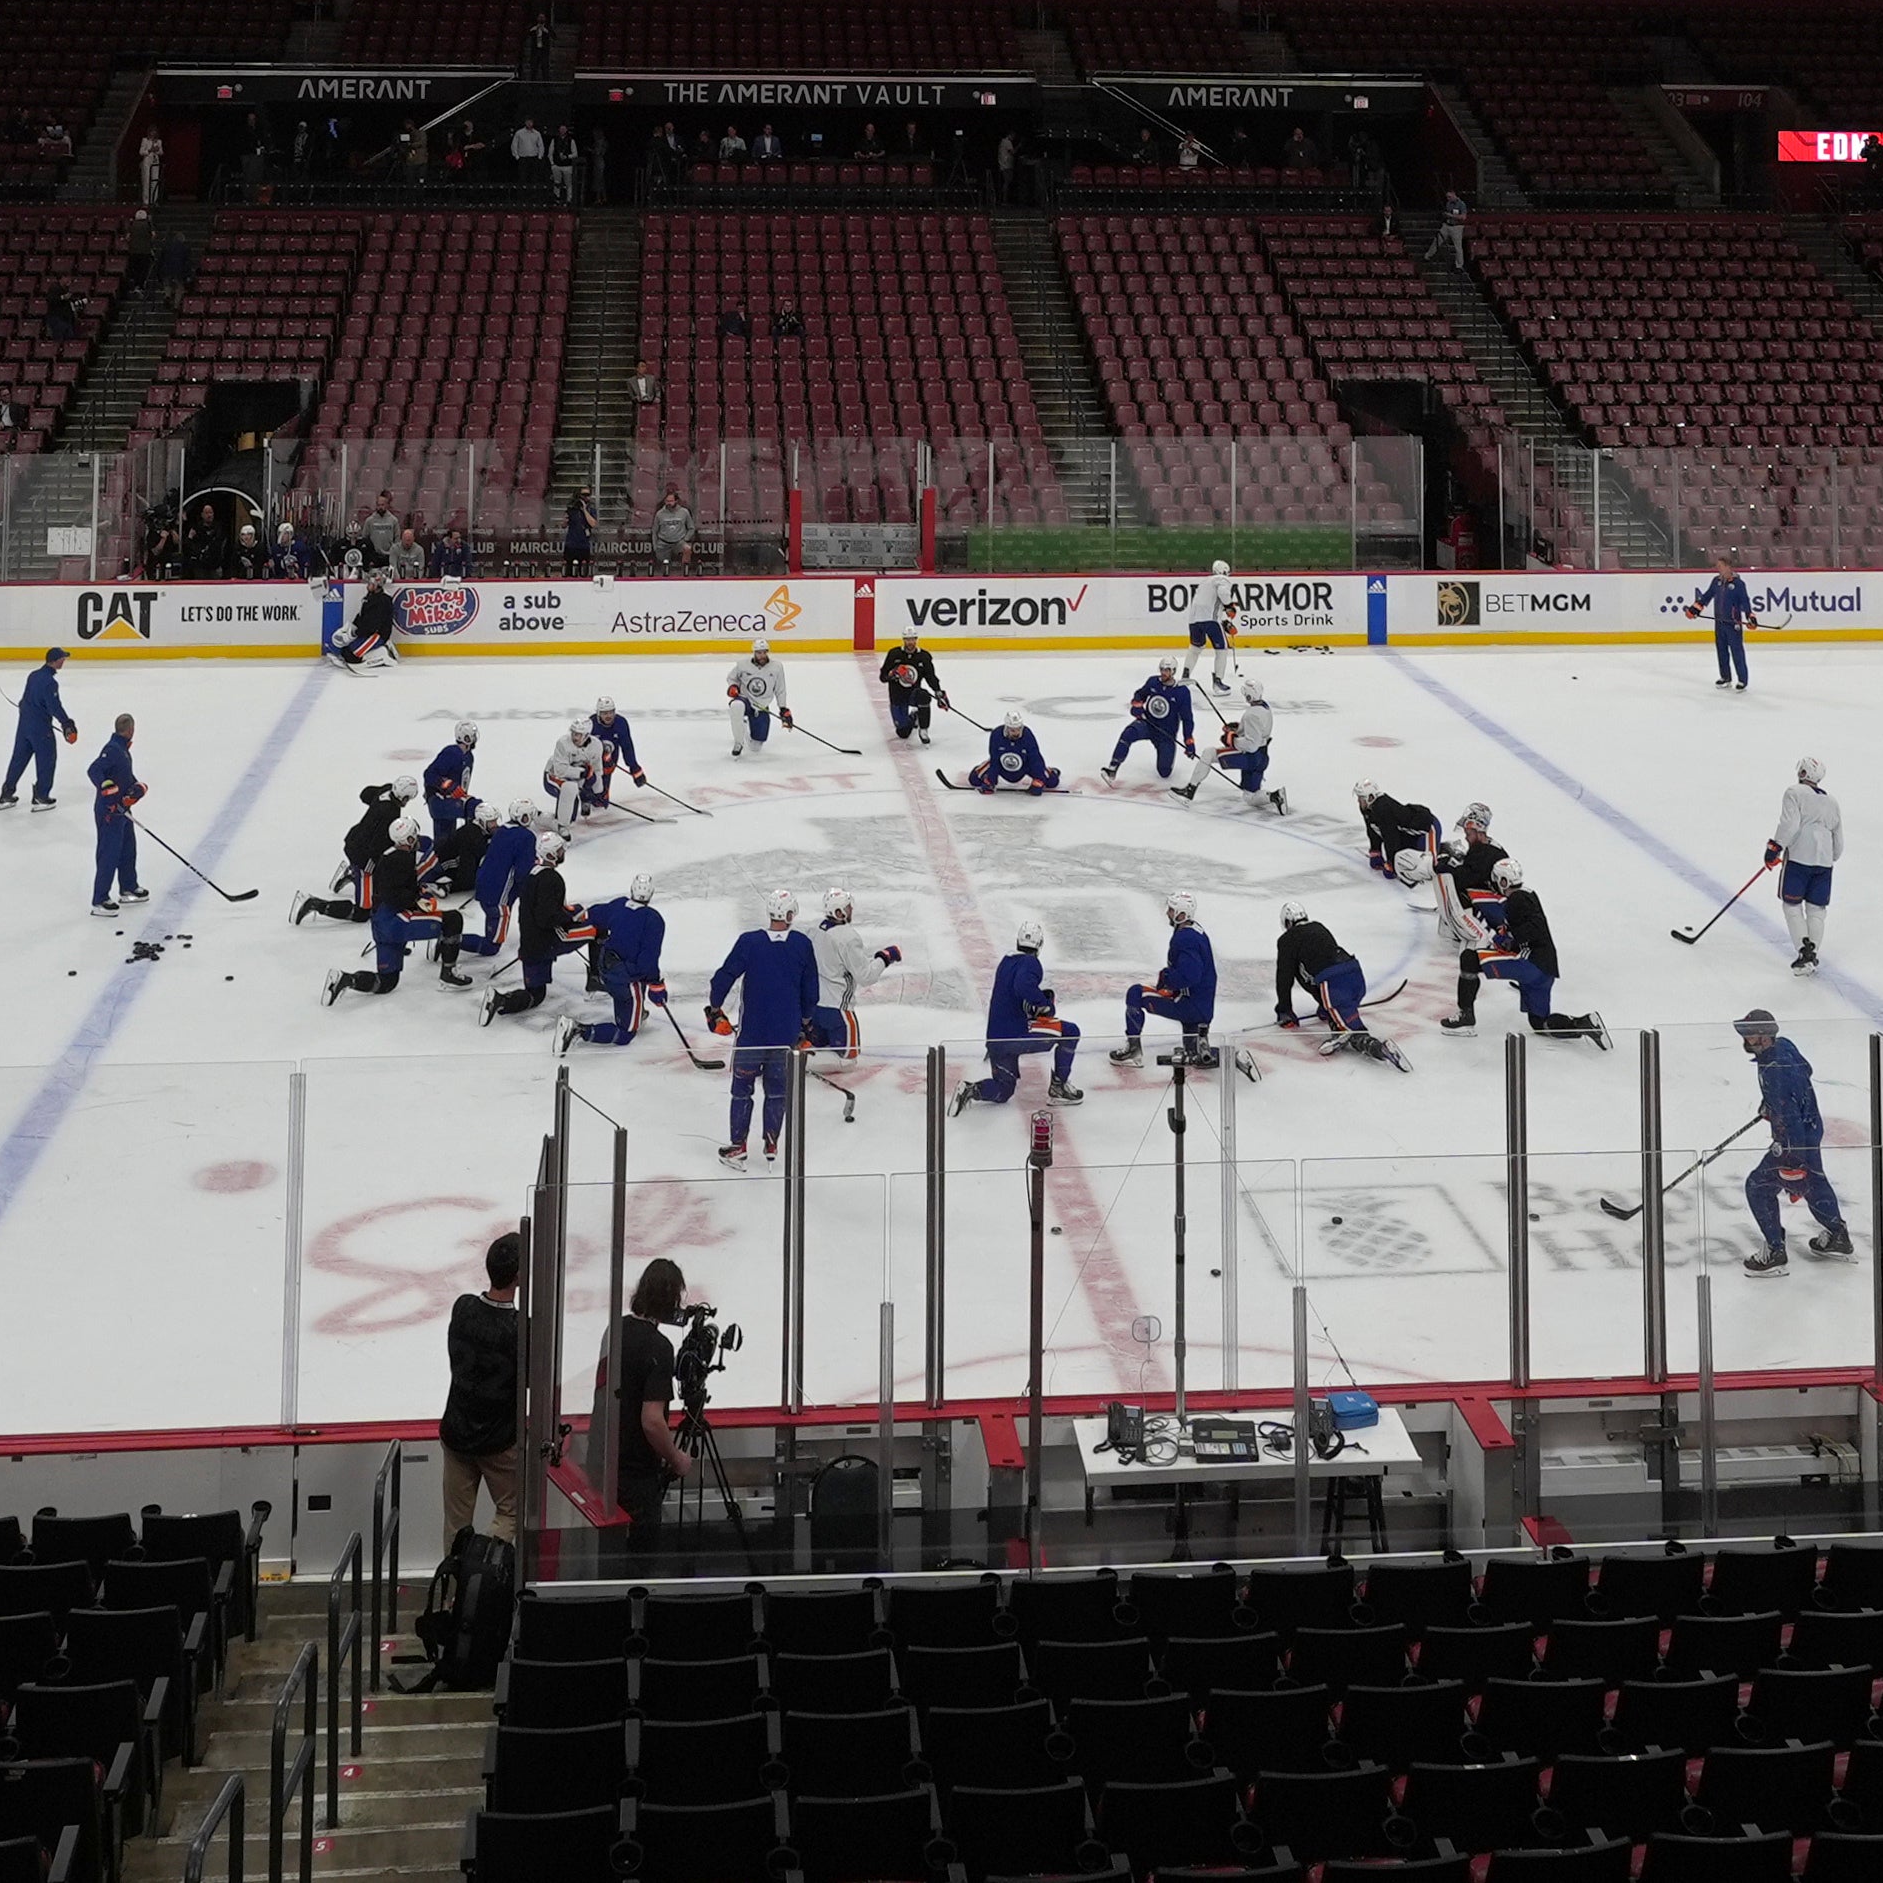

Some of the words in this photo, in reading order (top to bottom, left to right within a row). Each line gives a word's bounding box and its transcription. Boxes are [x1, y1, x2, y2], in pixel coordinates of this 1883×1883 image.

[298, 79, 432, 100] AMERANT
[664, 82, 709, 104] THE
[717, 83, 848, 105] AMERANT
[858, 85, 947, 106] VAULT
[1167, 86, 1294, 108] AMERANT
[400, 588, 468, 609] Jersey
[503, 595, 515, 609] a
[523, 591, 561, 609] sub
[907, 589, 1066, 627] verizon
[1485, 593, 1591, 612] BETMGM
[76, 592, 159, 640] CAT
[181, 605, 213, 622] LET'S
[215, 605, 233, 622] DO
[236, 605, 259, 622] THE
[498, 616, 565, 631] above
[610, 610, 766, 634] AstraZeneca
[1240, 614, 1288, 630] Sports
[1294, 613, 1334, 627] Drink
[424, 625, 449, 636] SUBS
